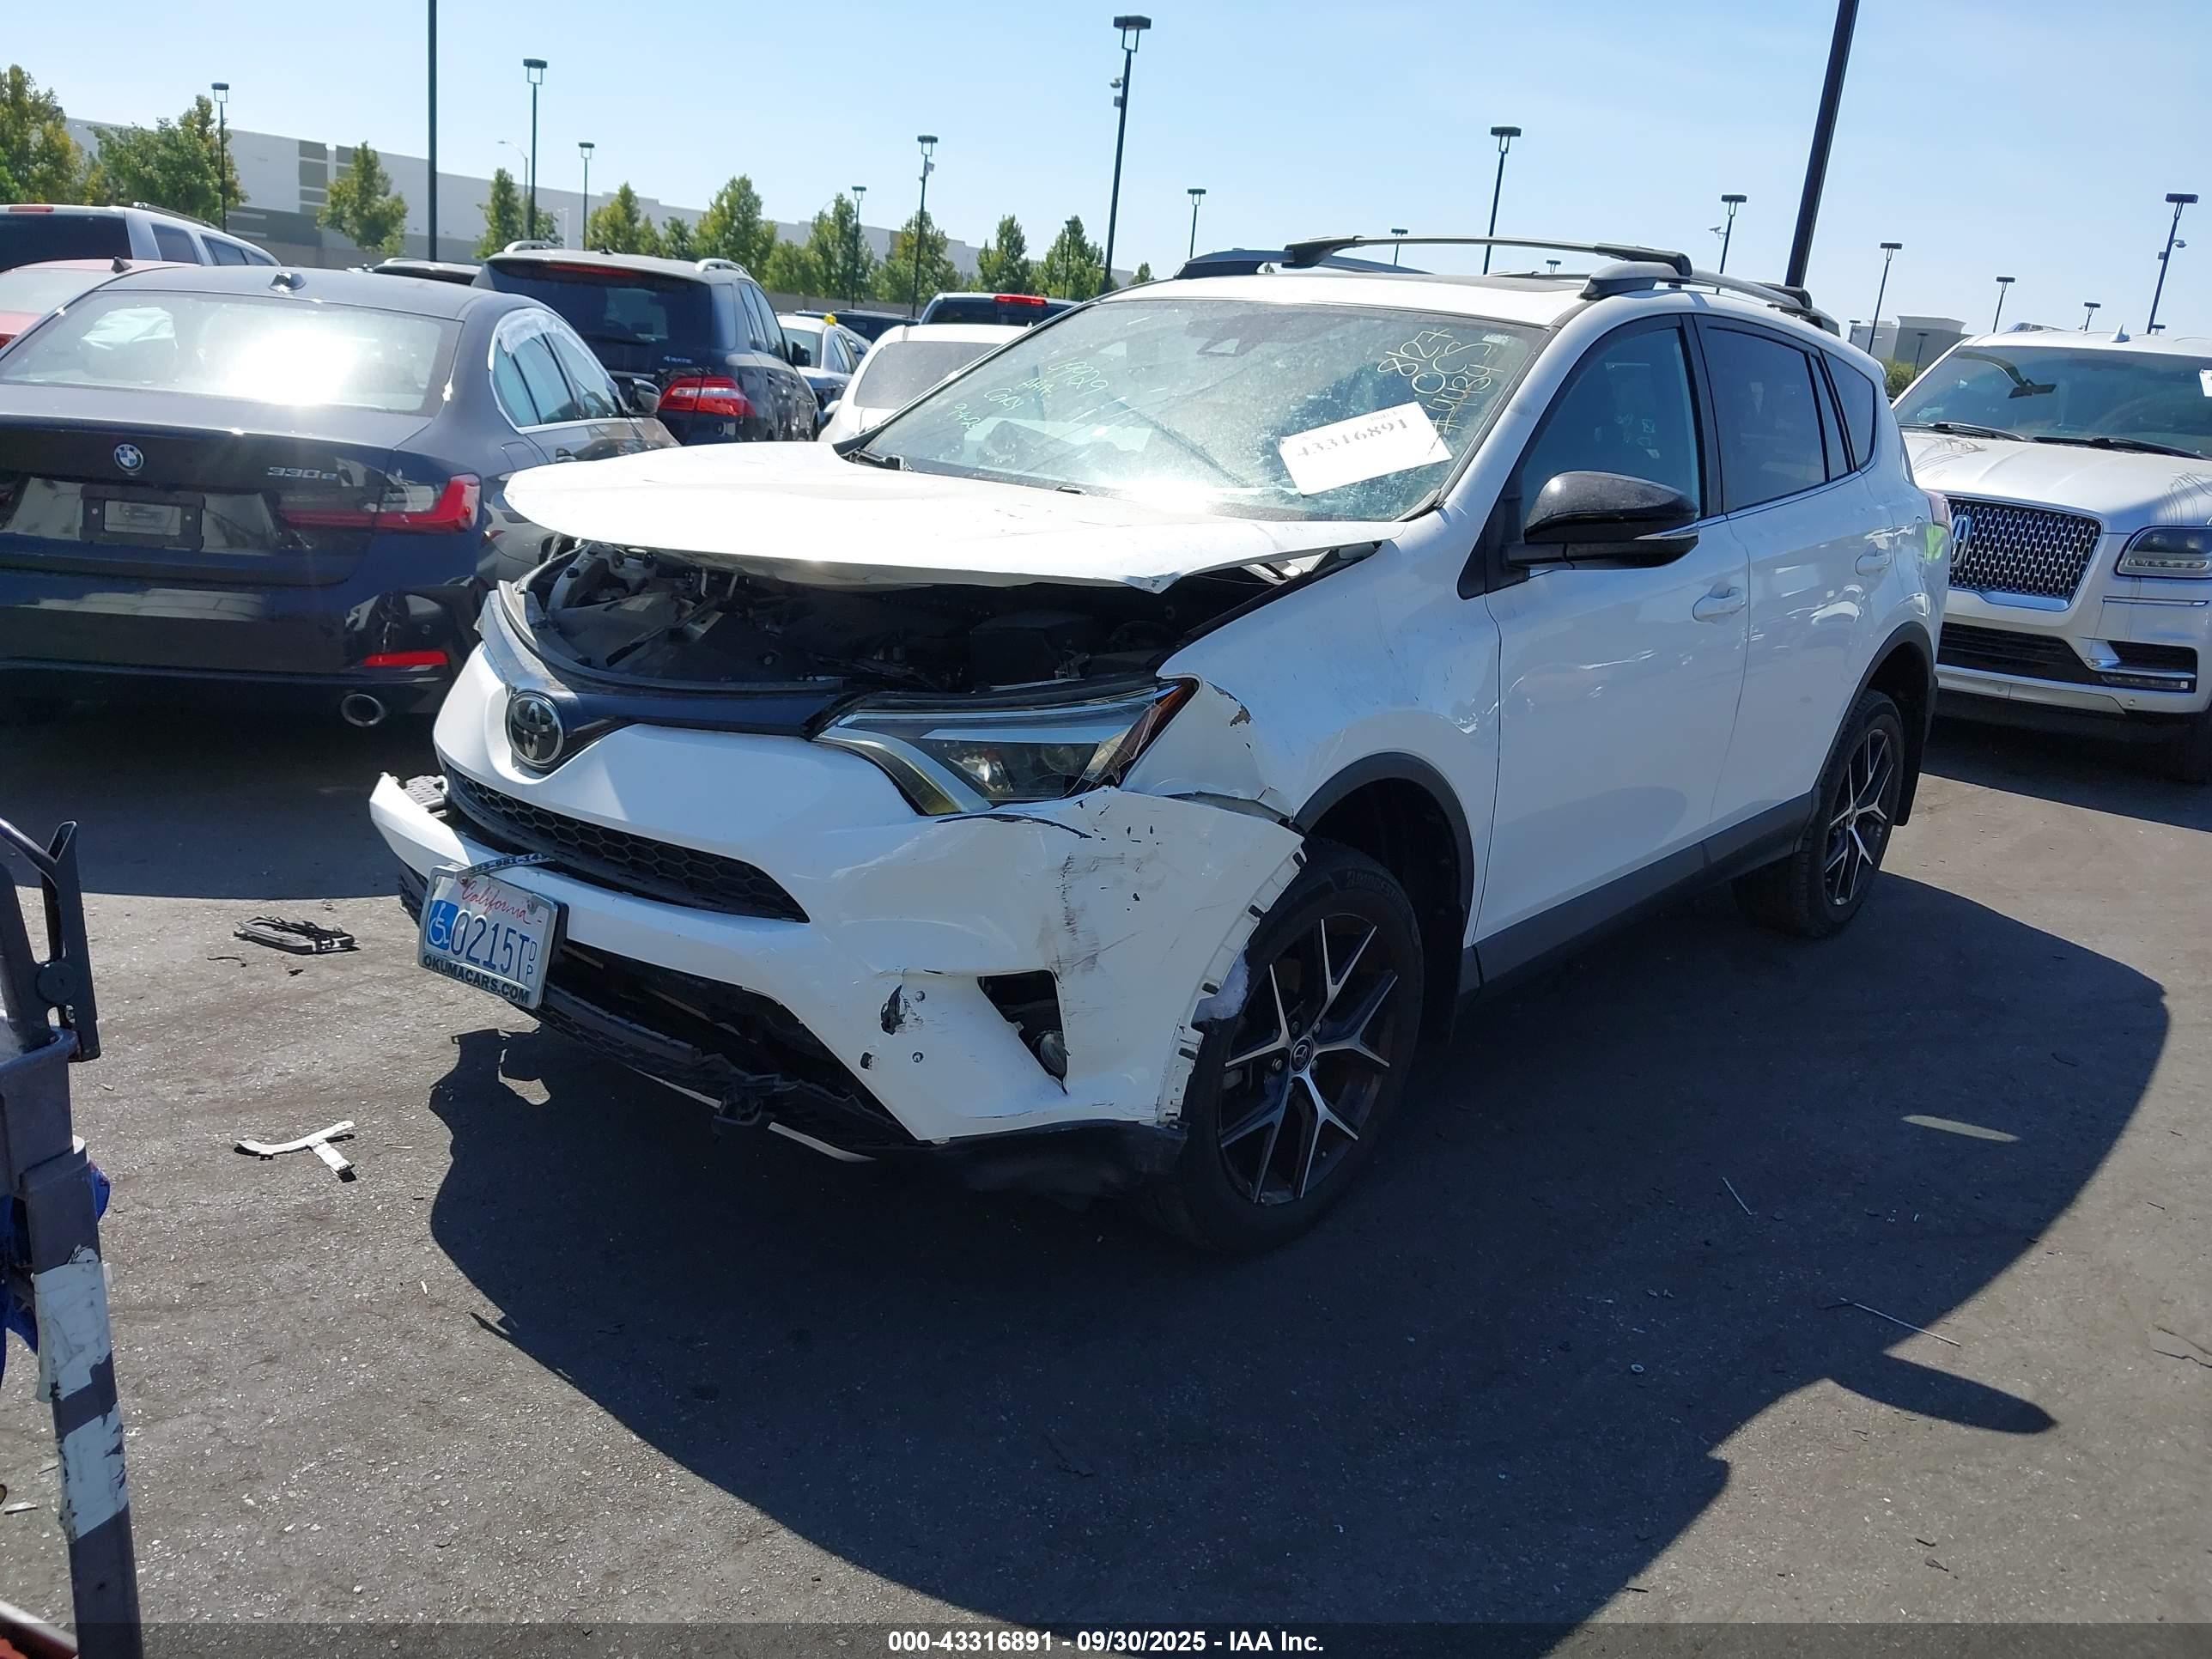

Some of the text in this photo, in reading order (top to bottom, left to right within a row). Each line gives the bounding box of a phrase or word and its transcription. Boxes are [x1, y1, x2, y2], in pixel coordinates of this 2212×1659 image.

[1297, 418, 1409, 458] 43316891
[461, 879, 532, 925] California
[422, 953, 531, 1004] OKUMACARS.COM
